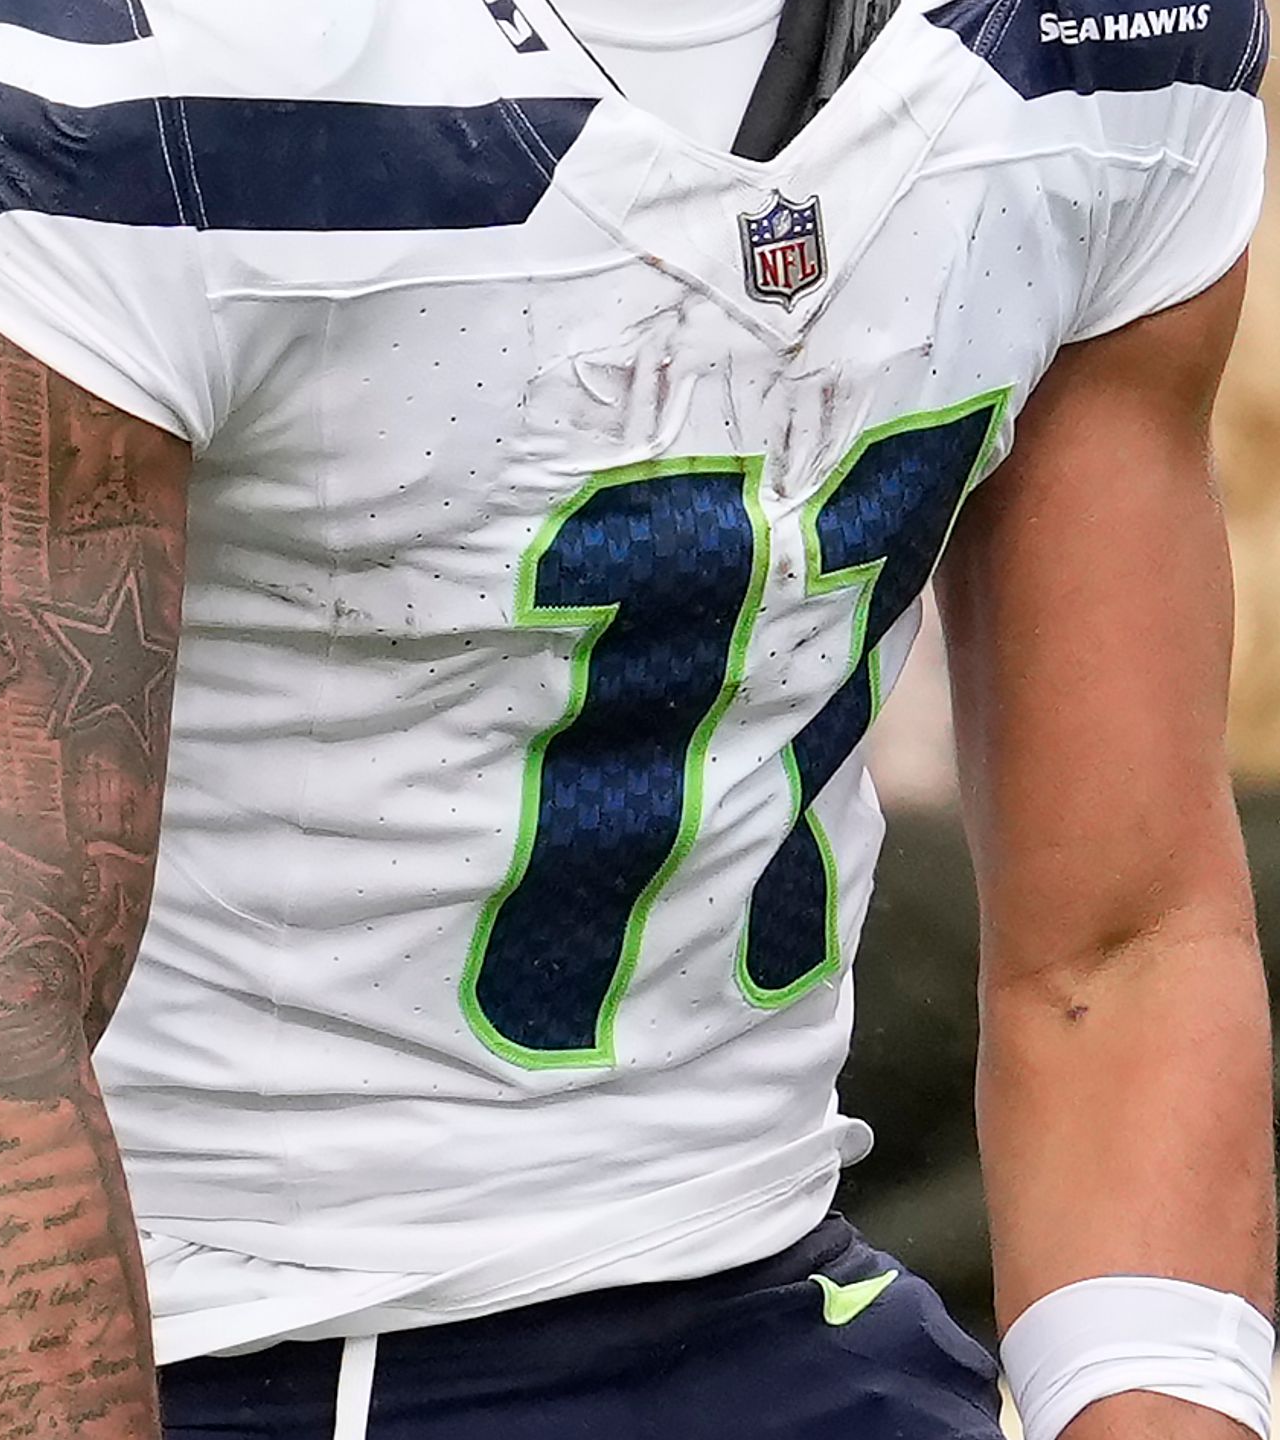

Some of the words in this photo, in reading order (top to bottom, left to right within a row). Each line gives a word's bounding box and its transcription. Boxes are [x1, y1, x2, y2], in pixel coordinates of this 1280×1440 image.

[1040, 3, 1211, 46] SEAHAWKS
[756, 240, 817, 288] NFL
[458, 384, 1017, 1070] 11
